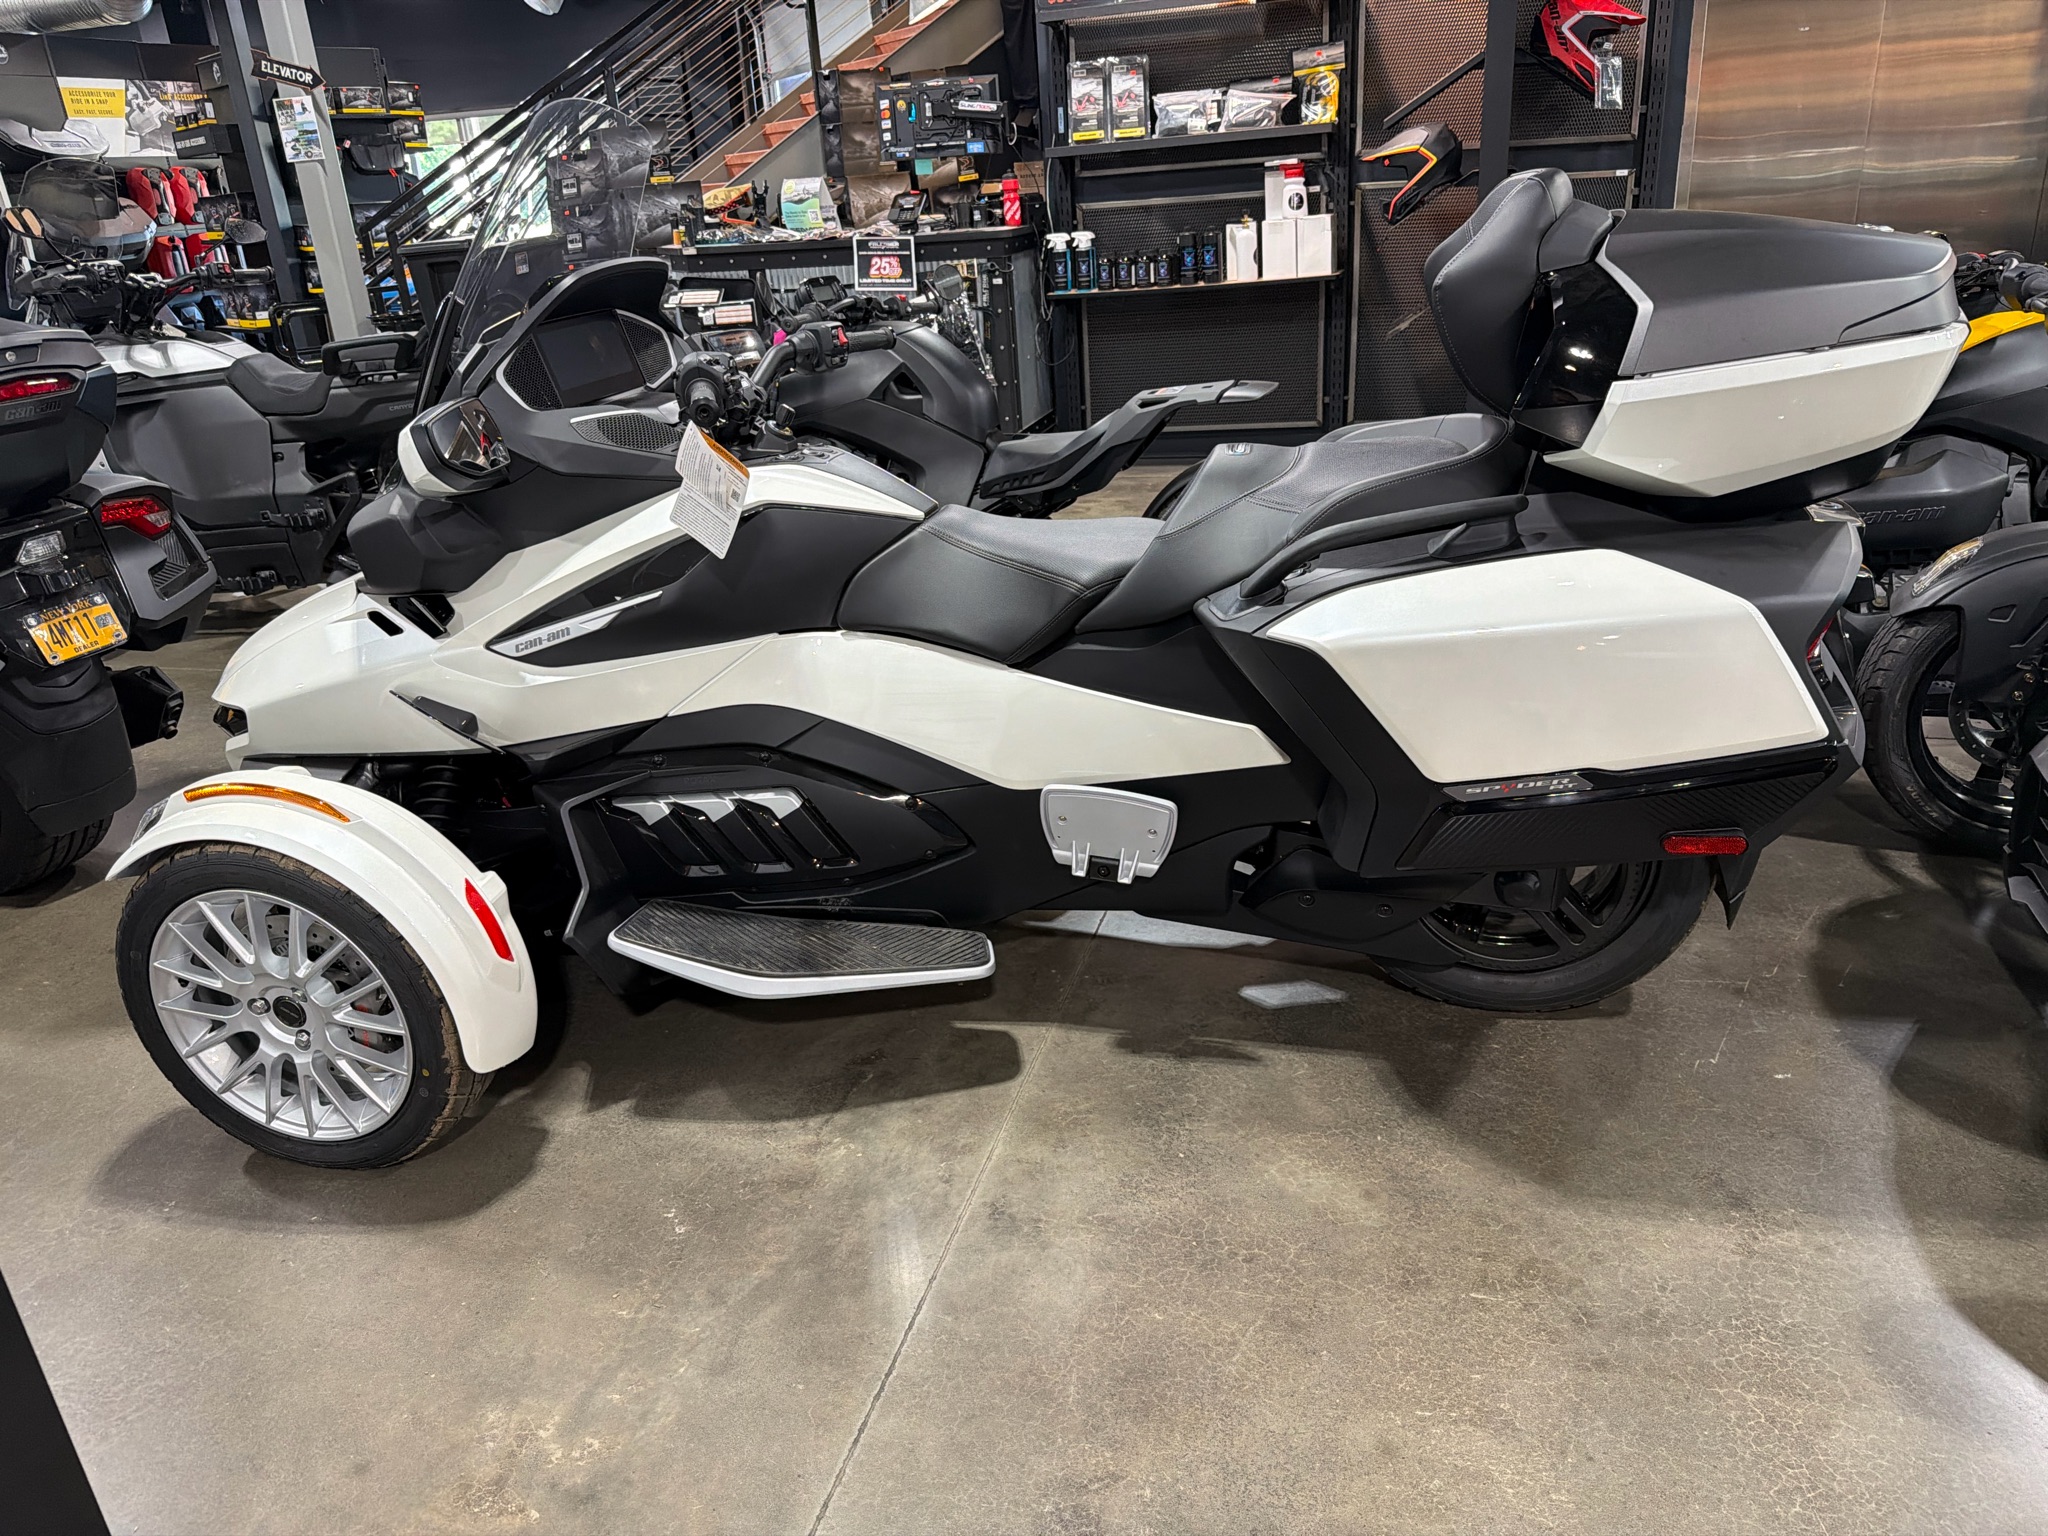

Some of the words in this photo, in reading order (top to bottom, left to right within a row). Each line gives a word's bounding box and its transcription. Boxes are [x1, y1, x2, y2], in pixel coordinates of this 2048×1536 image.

[1546, 0, 1570, 52] an-am
[261, 60, 313, 85] ELEVATOR
[68, 90, 102, 98] ACCESSORIZE
[103, 90, 116, 98] YOUR
[40, 608, 64, 621] NEW
[65, 598, 93, 613] YORK
[74, 640, 100, 653] DEALER
[515, 626, 571, 653] can-am
[1466, 778, 1570, 794] SPYDER
[1549, 782, 1578, 790] RT
